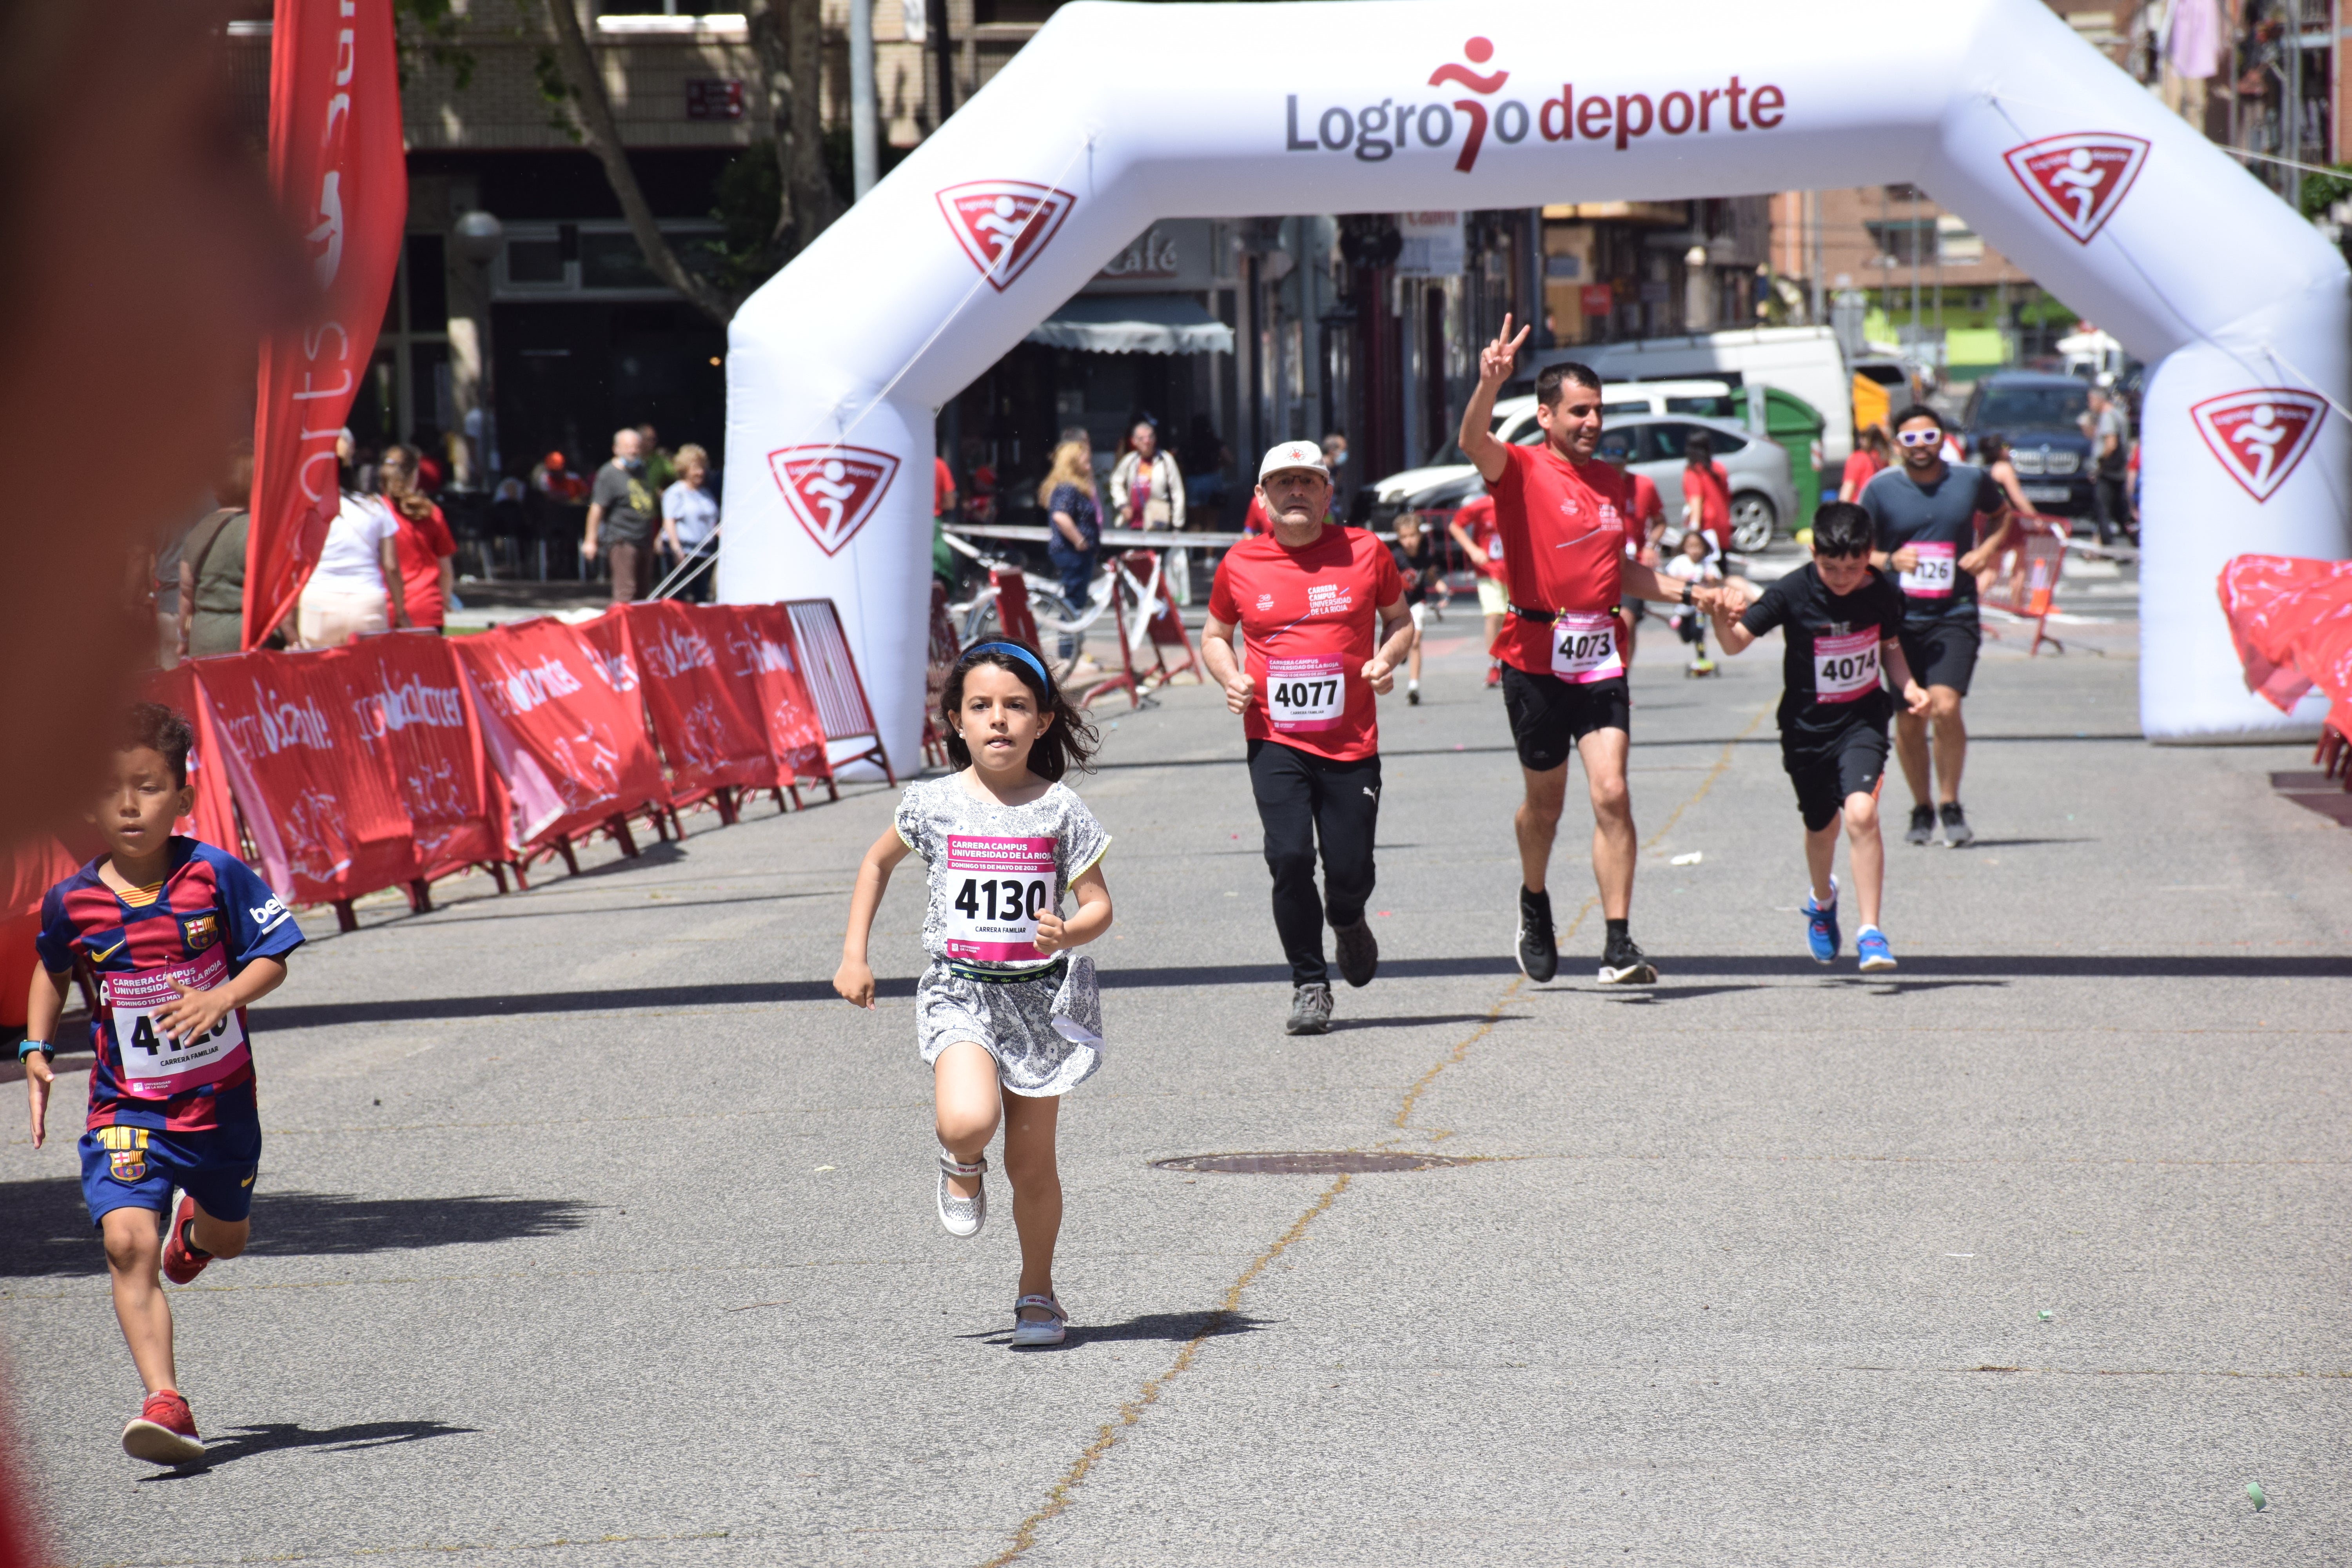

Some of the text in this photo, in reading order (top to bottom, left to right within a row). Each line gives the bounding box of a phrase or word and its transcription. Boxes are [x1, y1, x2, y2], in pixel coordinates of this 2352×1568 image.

[1539, 76, 1786, 152] deporte
[1913, 562, 1948, 579] 126
[1308, 584, 1338, 595] CARRERA
[1309, 592, 1336, 601] CAMPUS
[1310, 596, 1352, 608] UNIVERSIDAD
[1330, 604, 1348, 613] RIOJA
[1558, 632, 1611, 660] 4073
[1822, 648, 1876, 681] 4074
[1275, 679, 1338, 707] 4077
[952, 841, 991, 849] CARRERA
[952, 849, 1009, 858] UNIVERSIDAD
[955, 878, 1046, 921] 4130
[113, 976, 155, 987] CARRERA
[114, 960, 222, 995] UNIVERSIDA DE LA RIOJA
[116, 998, 147, 1006] DOMINGO
[160, 1046, 219, 1066] CARRERA FAMILIAR
